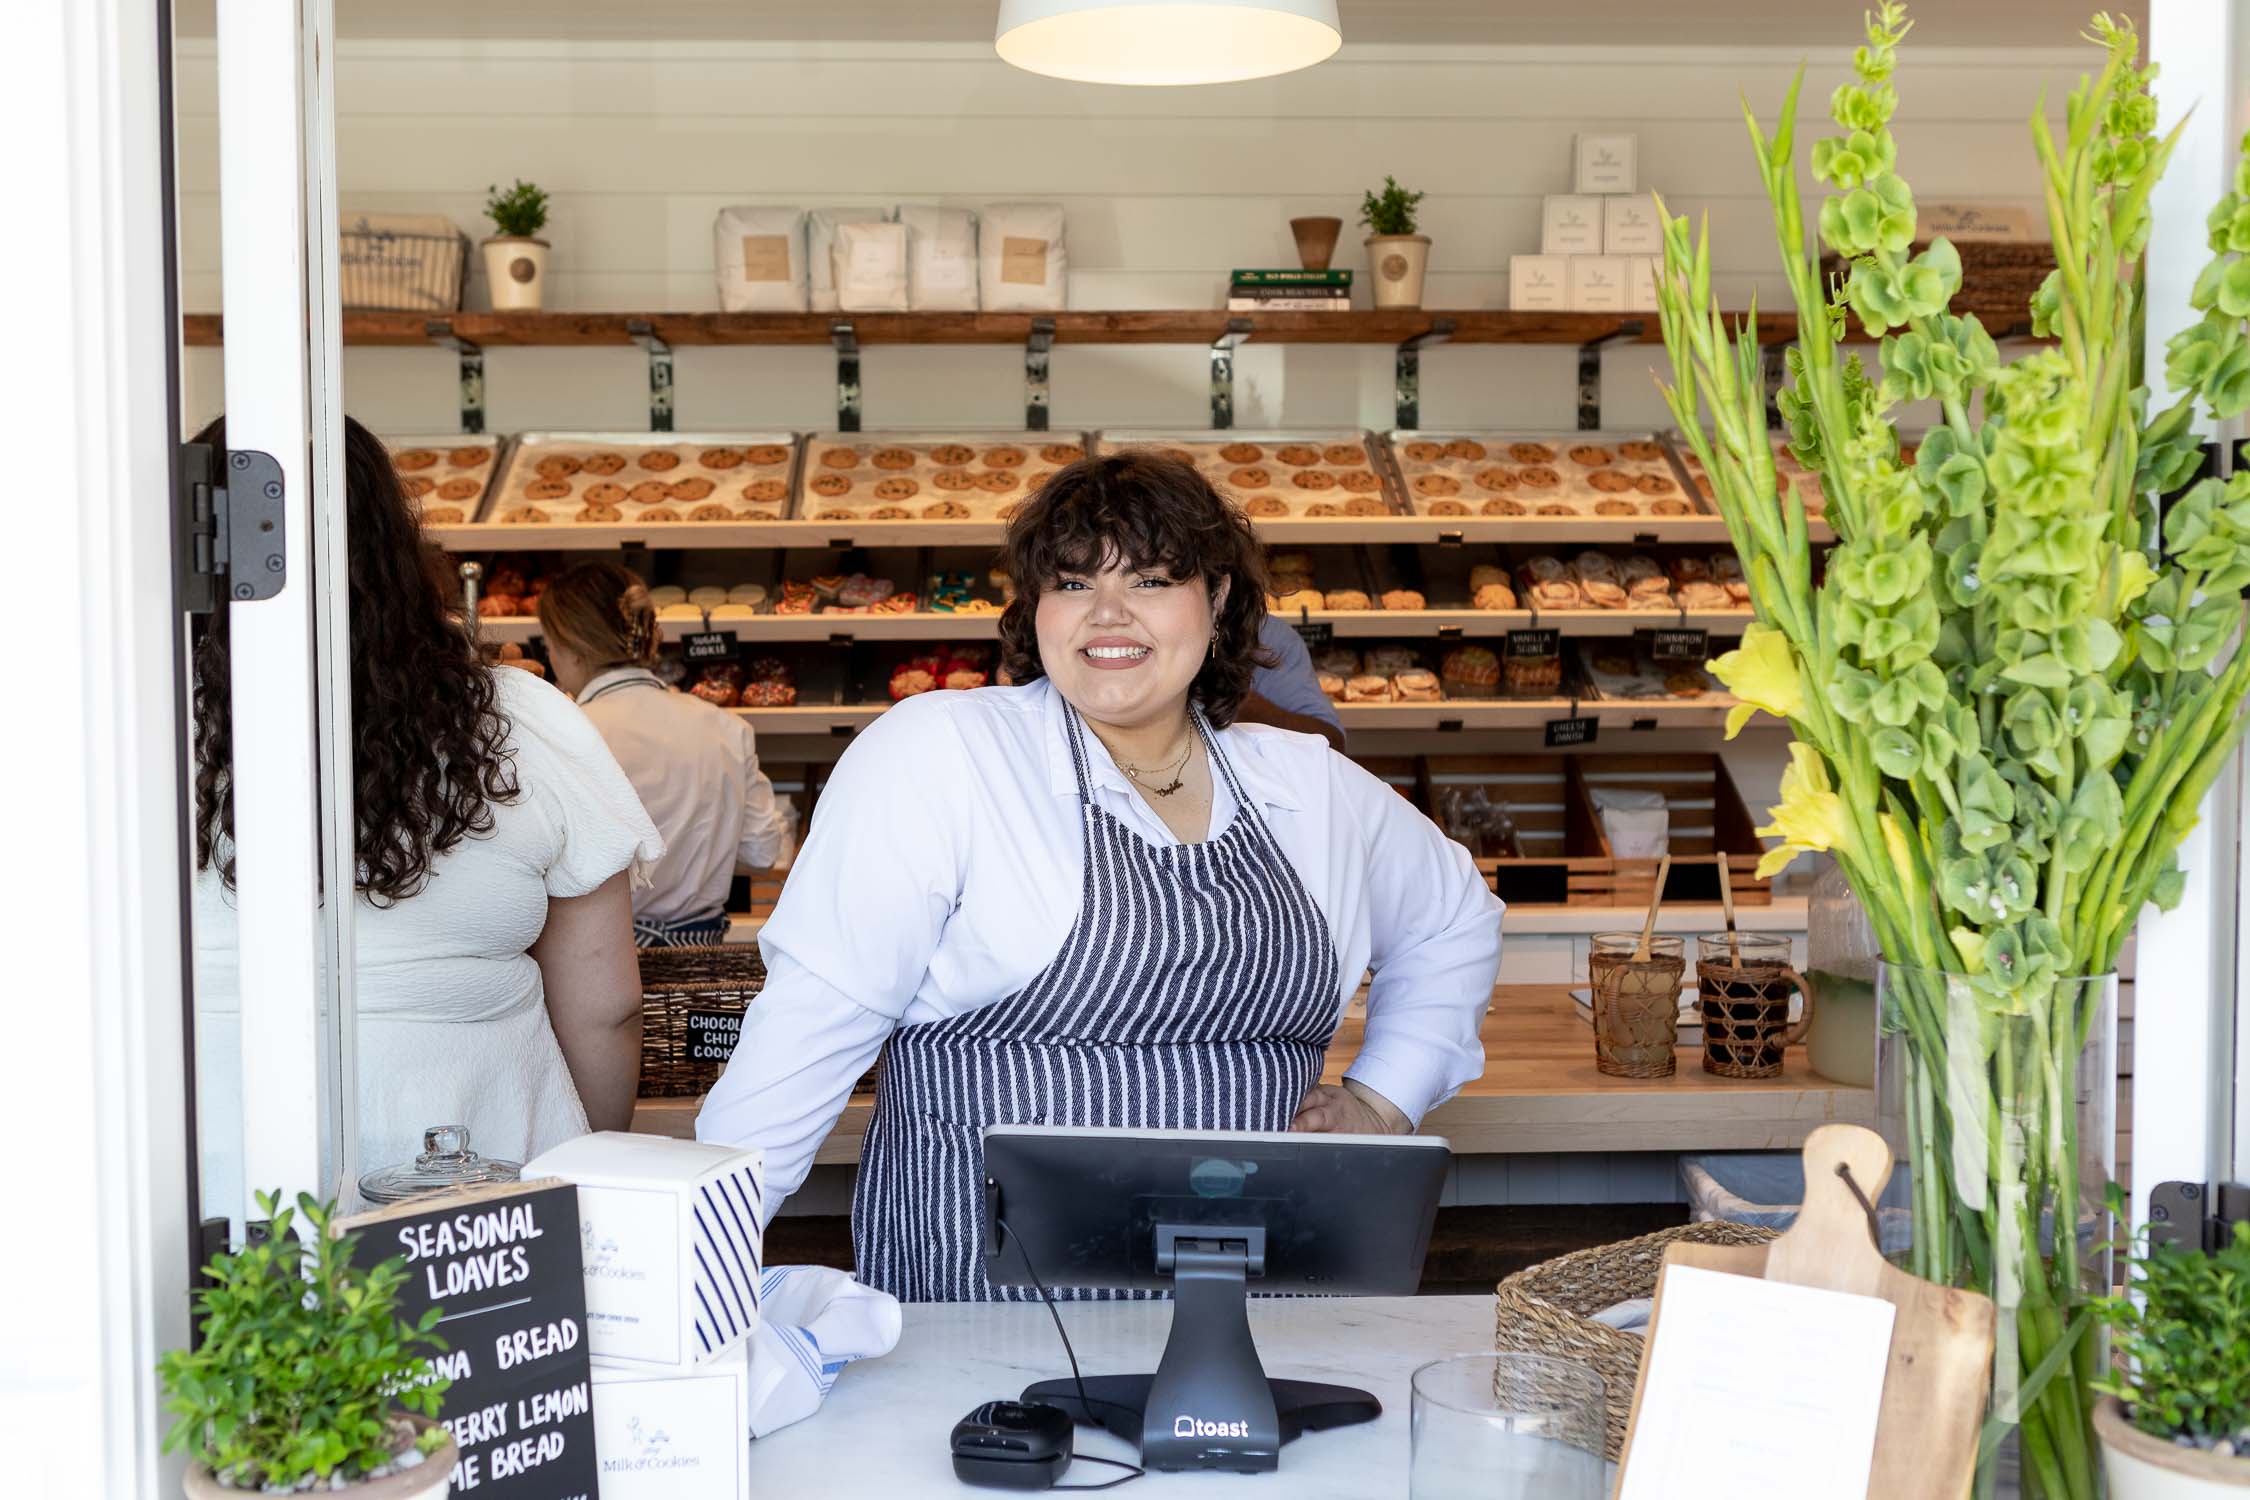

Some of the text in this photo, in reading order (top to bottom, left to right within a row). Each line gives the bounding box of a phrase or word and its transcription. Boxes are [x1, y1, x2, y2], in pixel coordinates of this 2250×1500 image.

[691, 634, 723, 646] SUGAR
[1512, 632, 1551, 644] VANILLA
[1658, 633, 1703, 645] CINNAMON
[689, 644, 727, 657] COOKIE
[690, 1015, 741, 1031] CHOCOL
[703, 1031, 738, 1046] CHIP
[694, 1044, 733, 1060] COOK
[398, 1203, 544, 1263] SEASONAL
[426, 1246, 530, 1300] LOAVES
[495, 1317, 580, 1370] BREAD
[518, 1381, 590, 1431] LEMON
[1195, 1417, 1249, 1438] toast
[490, 1431, 566, 1481] BREAD
